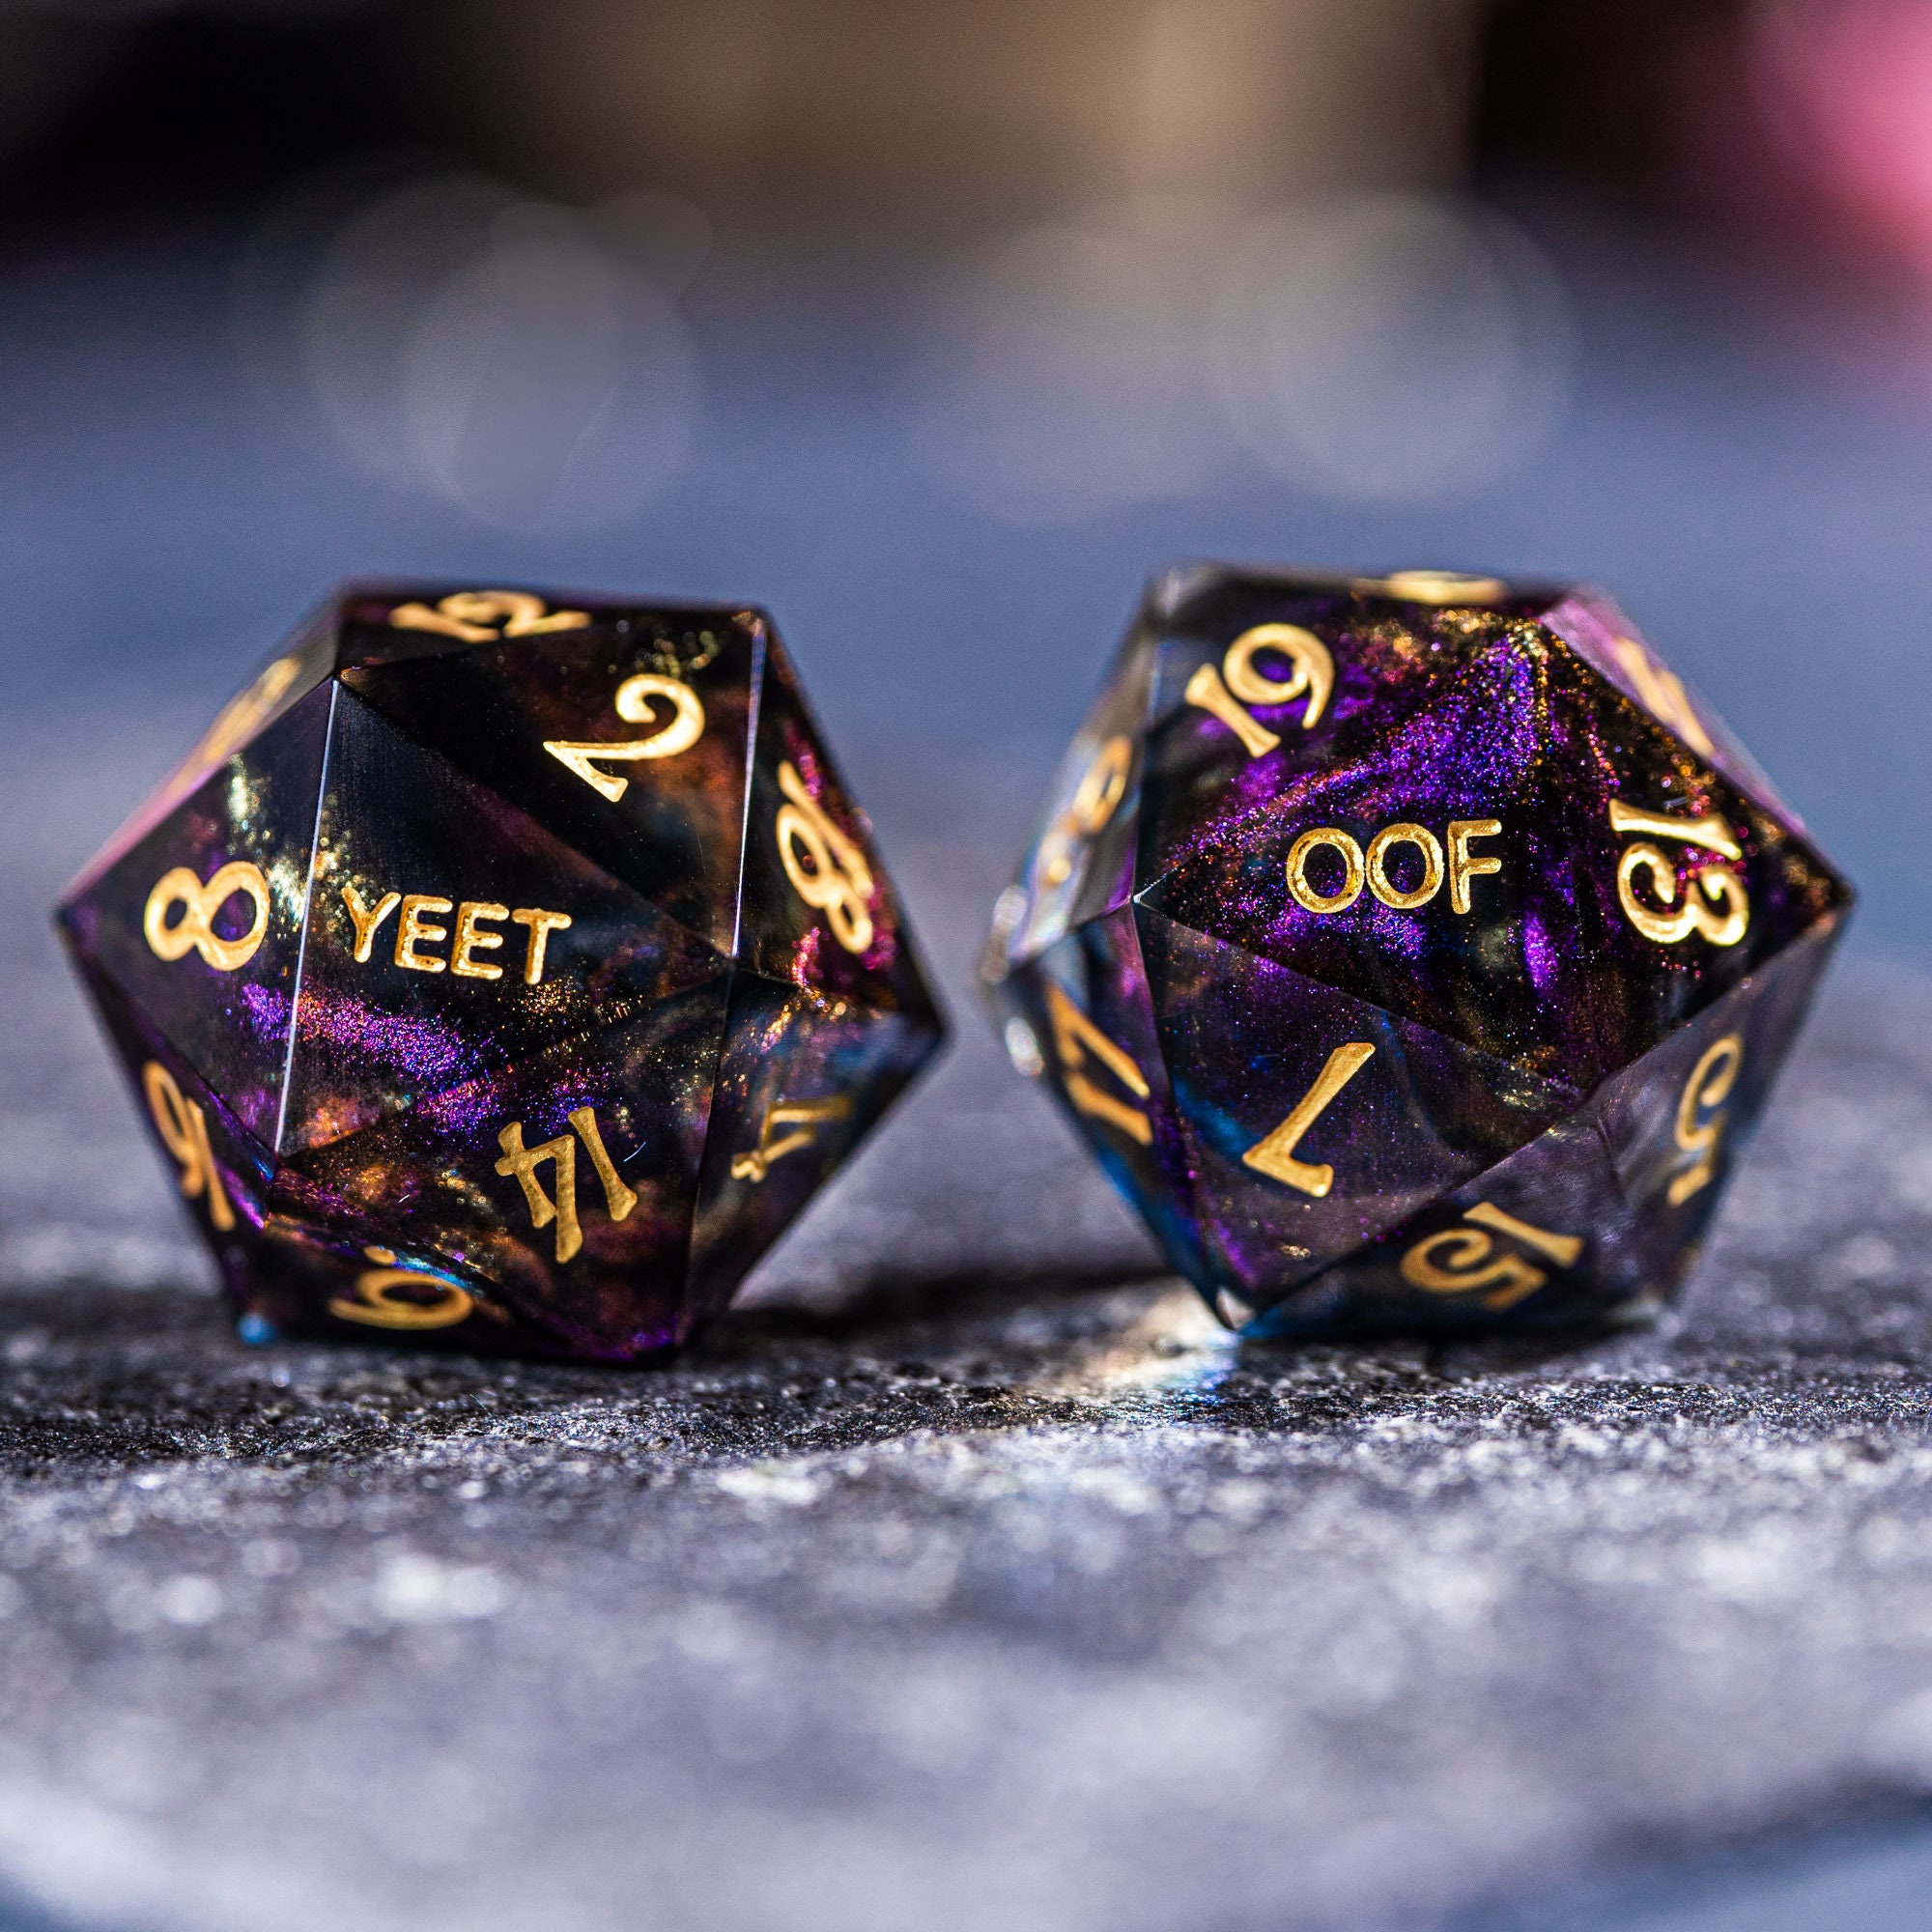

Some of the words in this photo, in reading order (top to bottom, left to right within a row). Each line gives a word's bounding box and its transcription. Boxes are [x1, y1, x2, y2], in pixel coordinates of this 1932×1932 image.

[543, 673, 705, 803] 2
[1184, 623, 1335, 758] 19
[143, 860, 270, 973] 8
[1286, 819, 1502, 915] OOF
[1609, 798, 1749, 947] 13
[341, 886, 573, 985] YEET
[731, 1094, 852, 1182] 4
[1242, 1042, 1376, 1198] 7
[1675, 1033, 1743, 1208] 5
[495, 1107, 638, 1264] 14
[1400, 1201, 1585, 1313] 15
